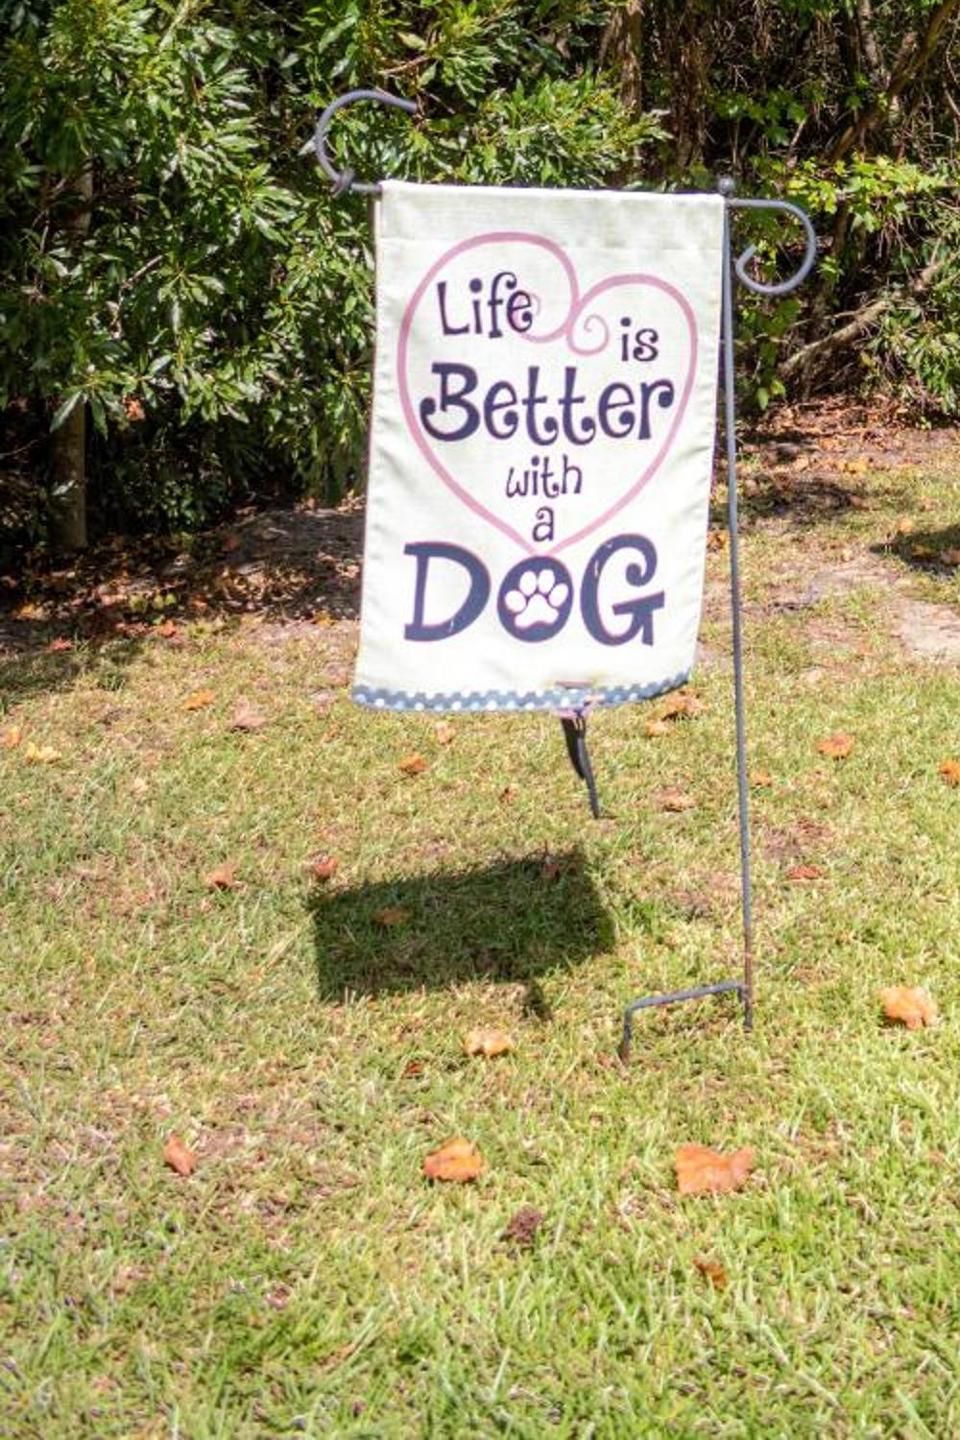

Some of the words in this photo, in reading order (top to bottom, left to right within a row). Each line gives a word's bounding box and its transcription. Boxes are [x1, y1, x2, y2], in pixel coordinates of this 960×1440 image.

[436, 271, 534, 339] Life
[620, 316, 659, 362] is
[420, 362, 675, 446] Better
[505, 454, 584, 499] with
[531, 506, 555, 543] a
[403, 533, 666, 647] DOG
